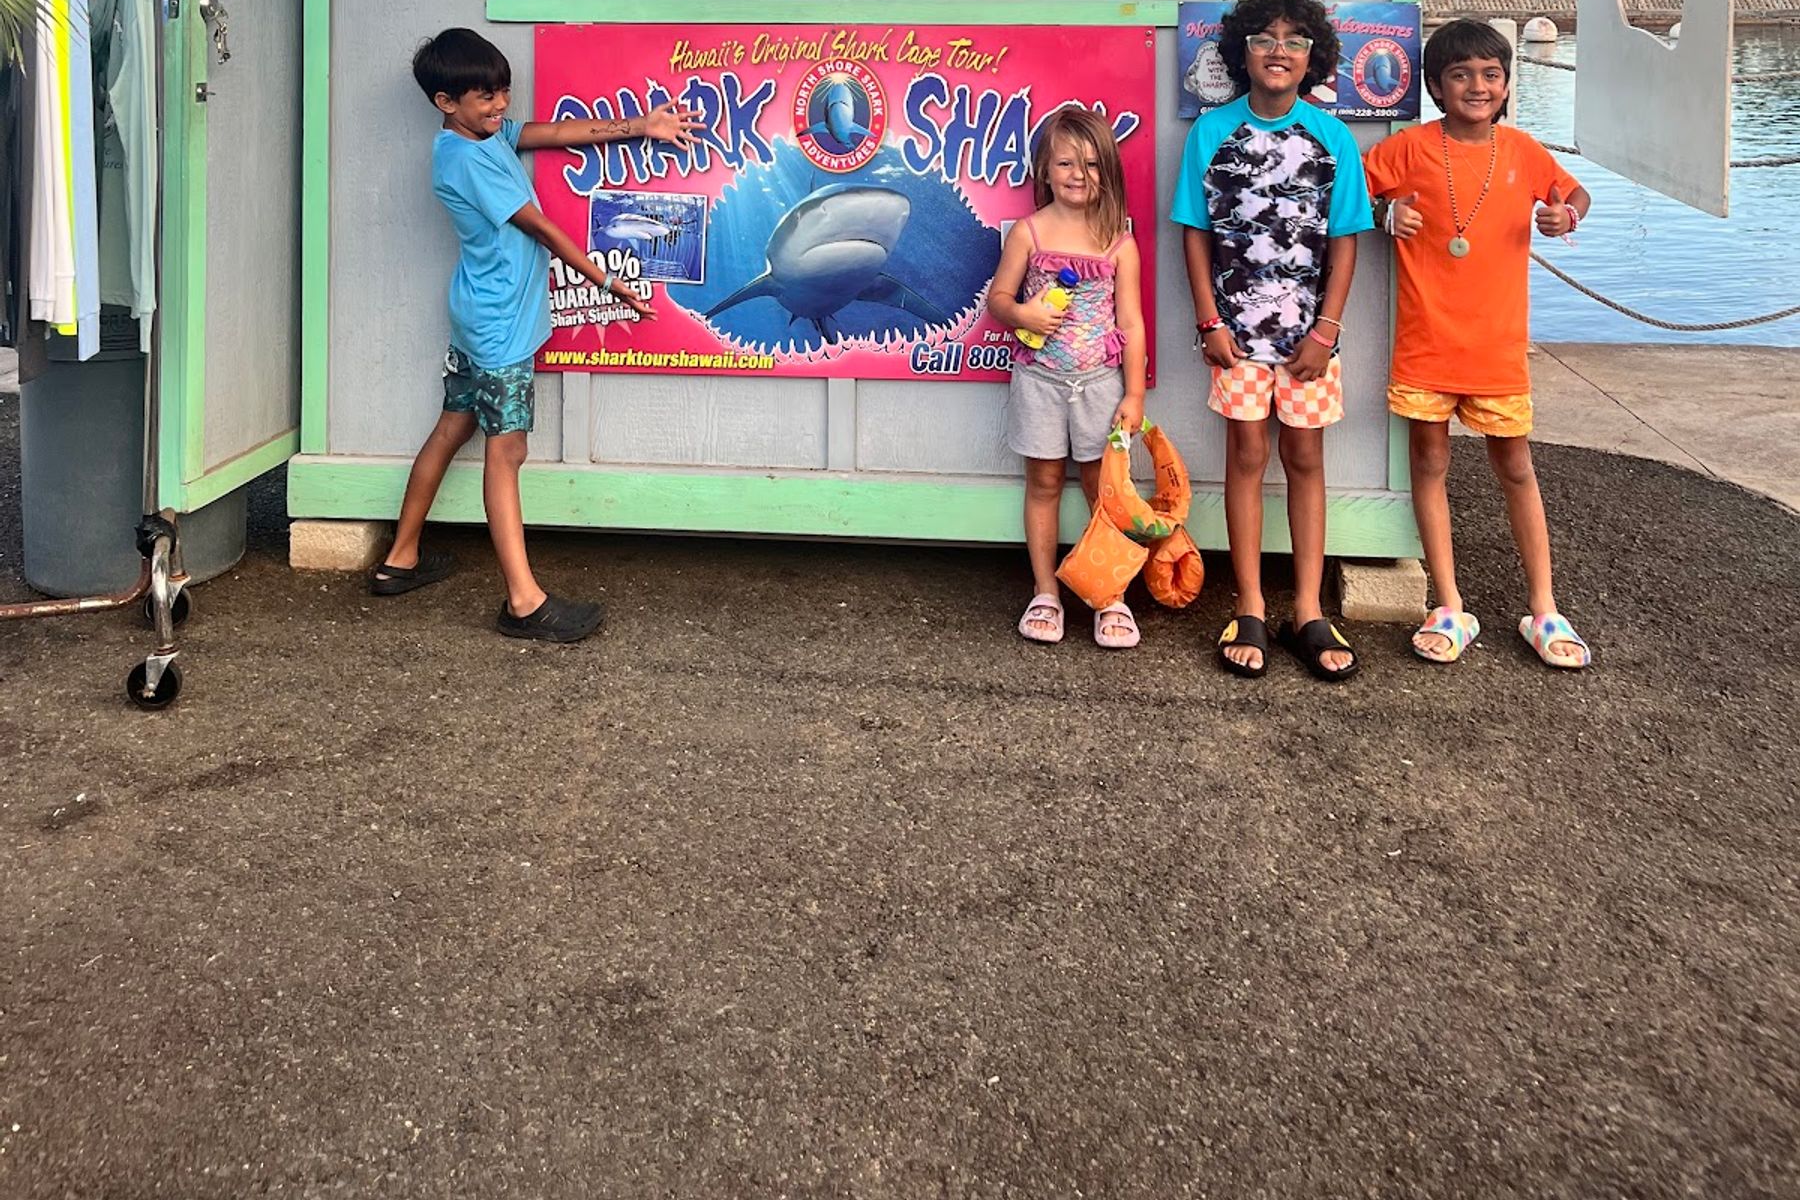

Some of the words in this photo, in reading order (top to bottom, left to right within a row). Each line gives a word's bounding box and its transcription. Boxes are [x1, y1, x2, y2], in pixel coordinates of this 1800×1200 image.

[669, 40, 745, 74] Hawaii's
[750, 33, 825, 74] Original
[828, 28, 896, 62] Shark
[895, 30, 943, 80] Cage
[945, 37, 1010, 74] Tour!
[795, 74, 819, 116] NORTH
[817, 60, 862, 77] SHORE
[861, 74, 883, 116] SHARK
[551, 71, 777, 197] SHARK
[900, 71, 1140, 188] SHA
[801, 139, 877, 169] ADVENTURES
[550, 310, 586, 328] Shark
[982, 330, 1000, 342] For
[543, 347, 775, 370] www.sharktourshawaii.com
[910, 341, 963, 375] Call
